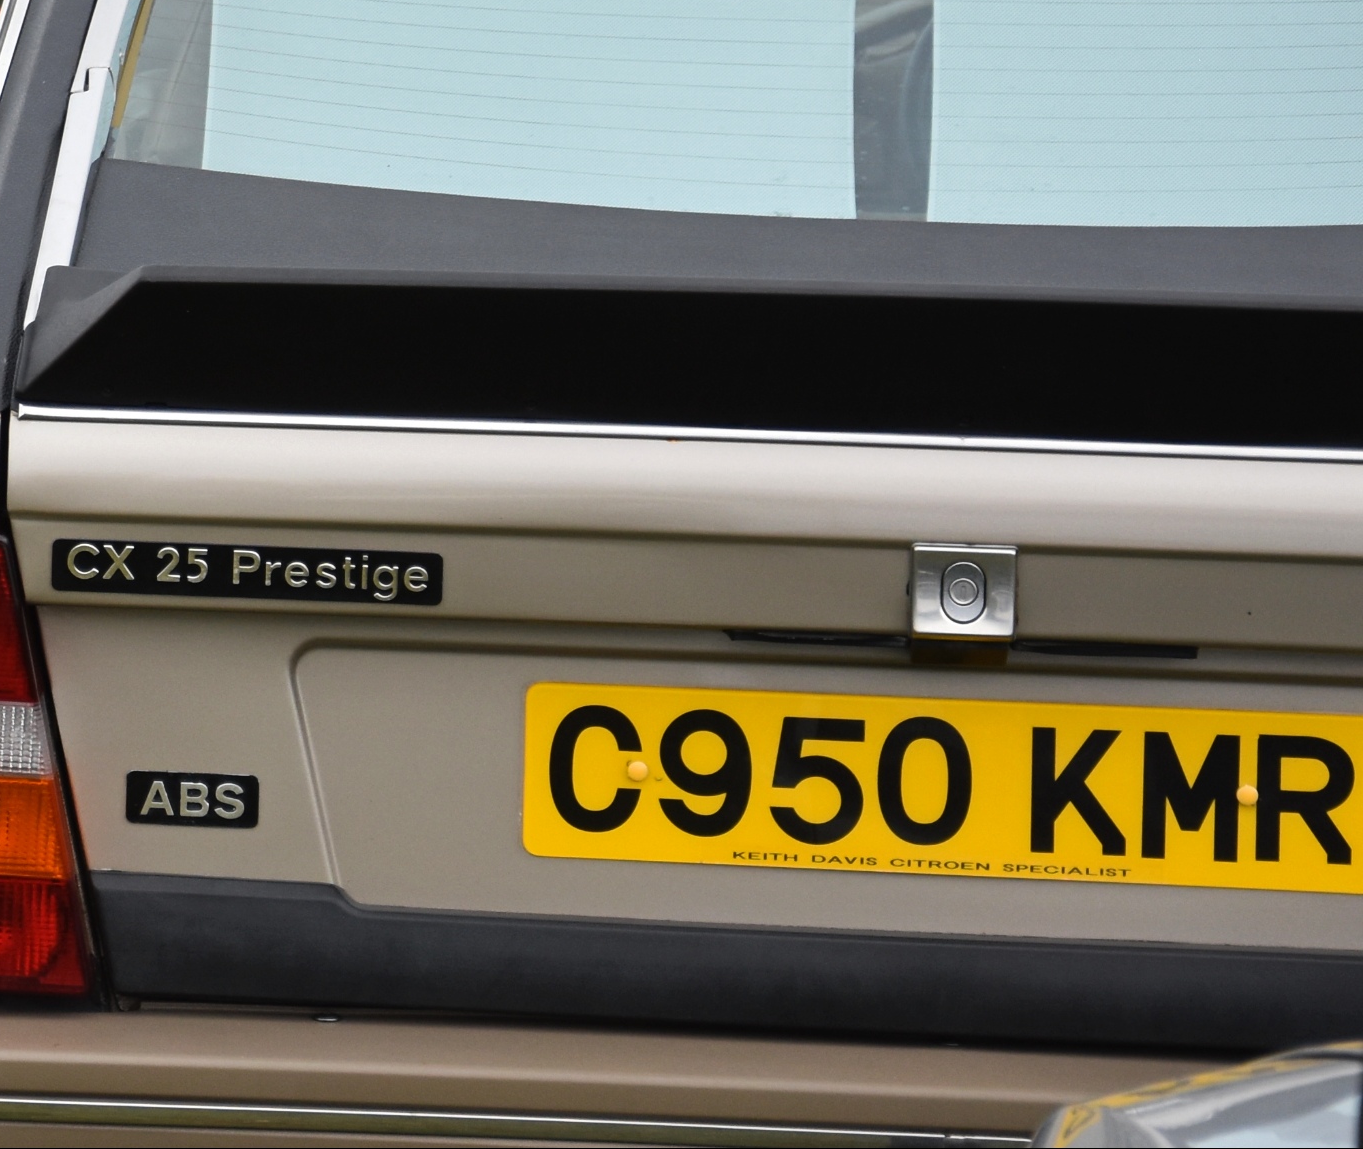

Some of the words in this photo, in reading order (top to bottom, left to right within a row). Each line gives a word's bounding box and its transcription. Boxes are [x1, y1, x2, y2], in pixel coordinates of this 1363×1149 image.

[67, 543, 135, 581] CX
[156, 546, 209, 584] 25
[232, 549, 429, 601] Prestige
[140, 780, 245, 820] ABS
[548, 704, 973, 847] C950
[1030, 726, 1356, 865] KMR
[732, 851, 799, 862] KEITH
[811, 854, 878, 867] DAVIS
[889, 858, 991, 871] CITROEN
[1003, 863, 1132, 878] SPECIALIST
